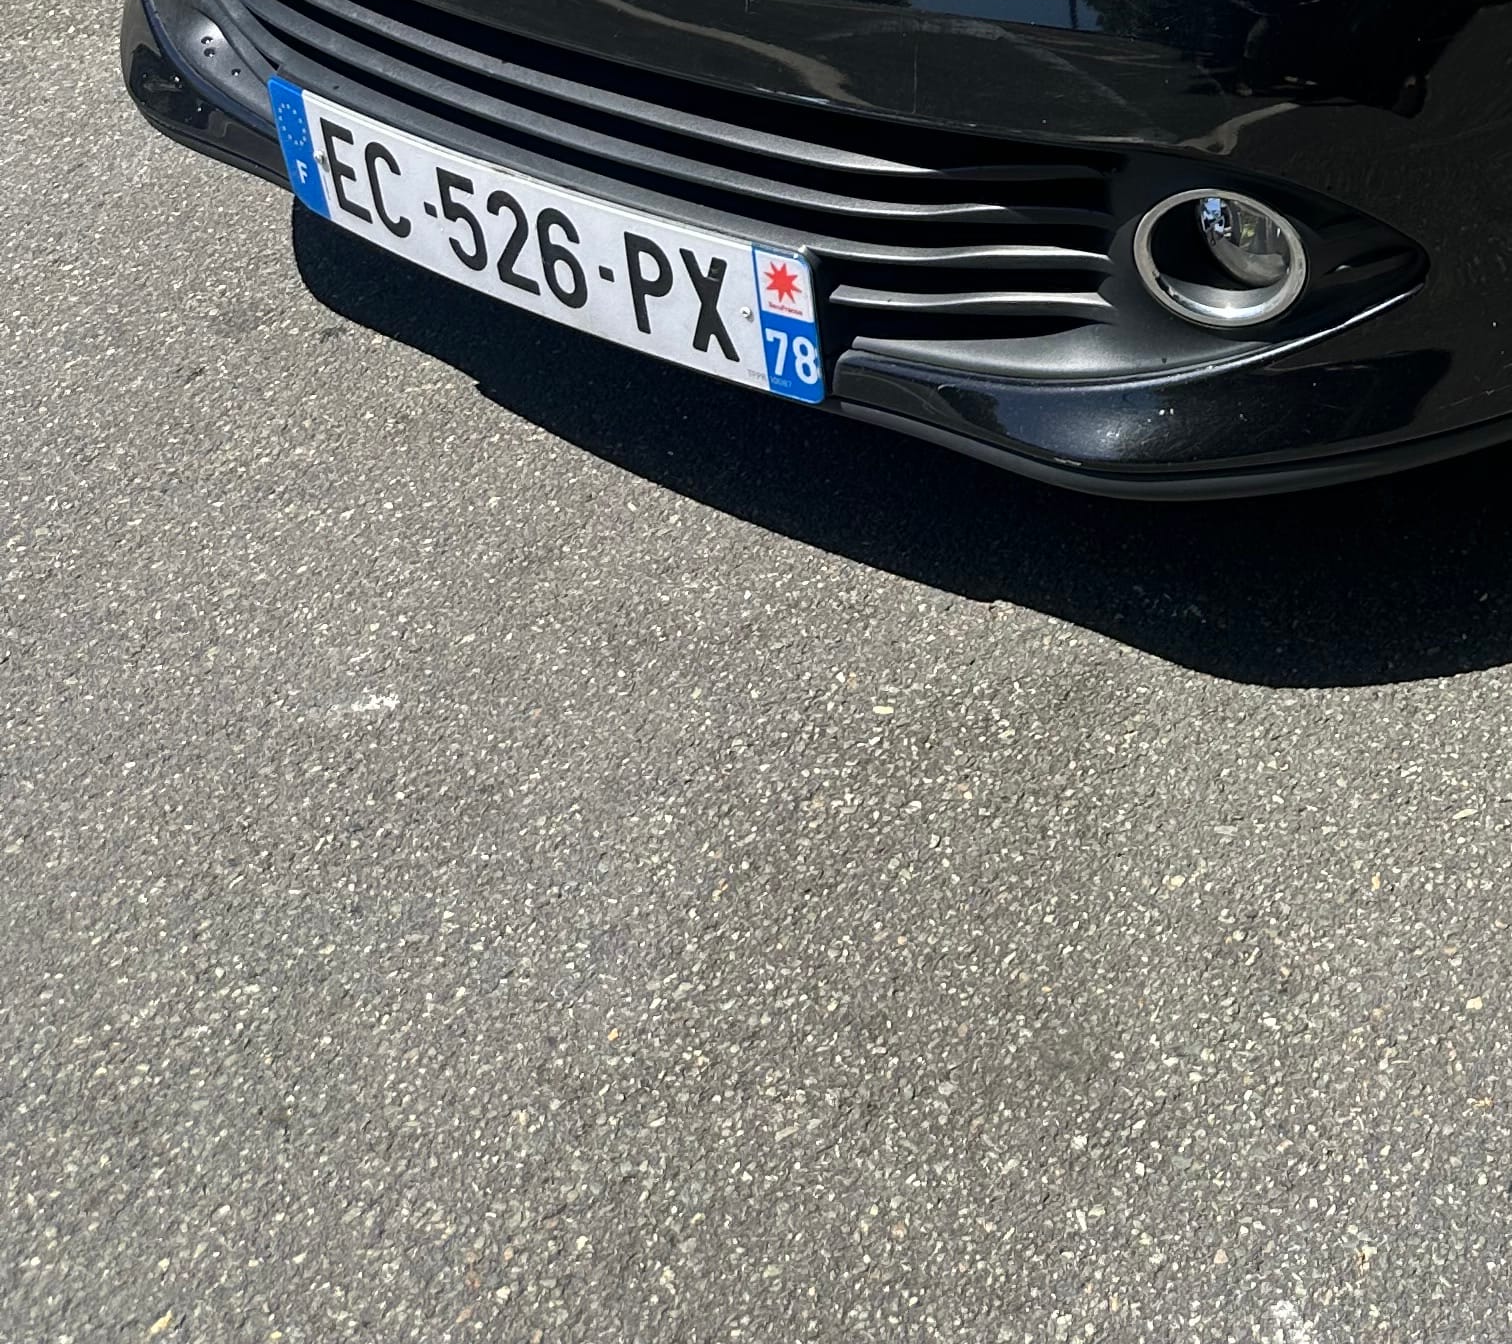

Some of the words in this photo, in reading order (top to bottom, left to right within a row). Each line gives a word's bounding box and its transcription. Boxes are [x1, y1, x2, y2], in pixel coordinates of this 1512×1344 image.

[296, 159, 308, 184] F
[320, 117, 740, 362] EC-526-PX
[765, 327, 818, 385] 78
